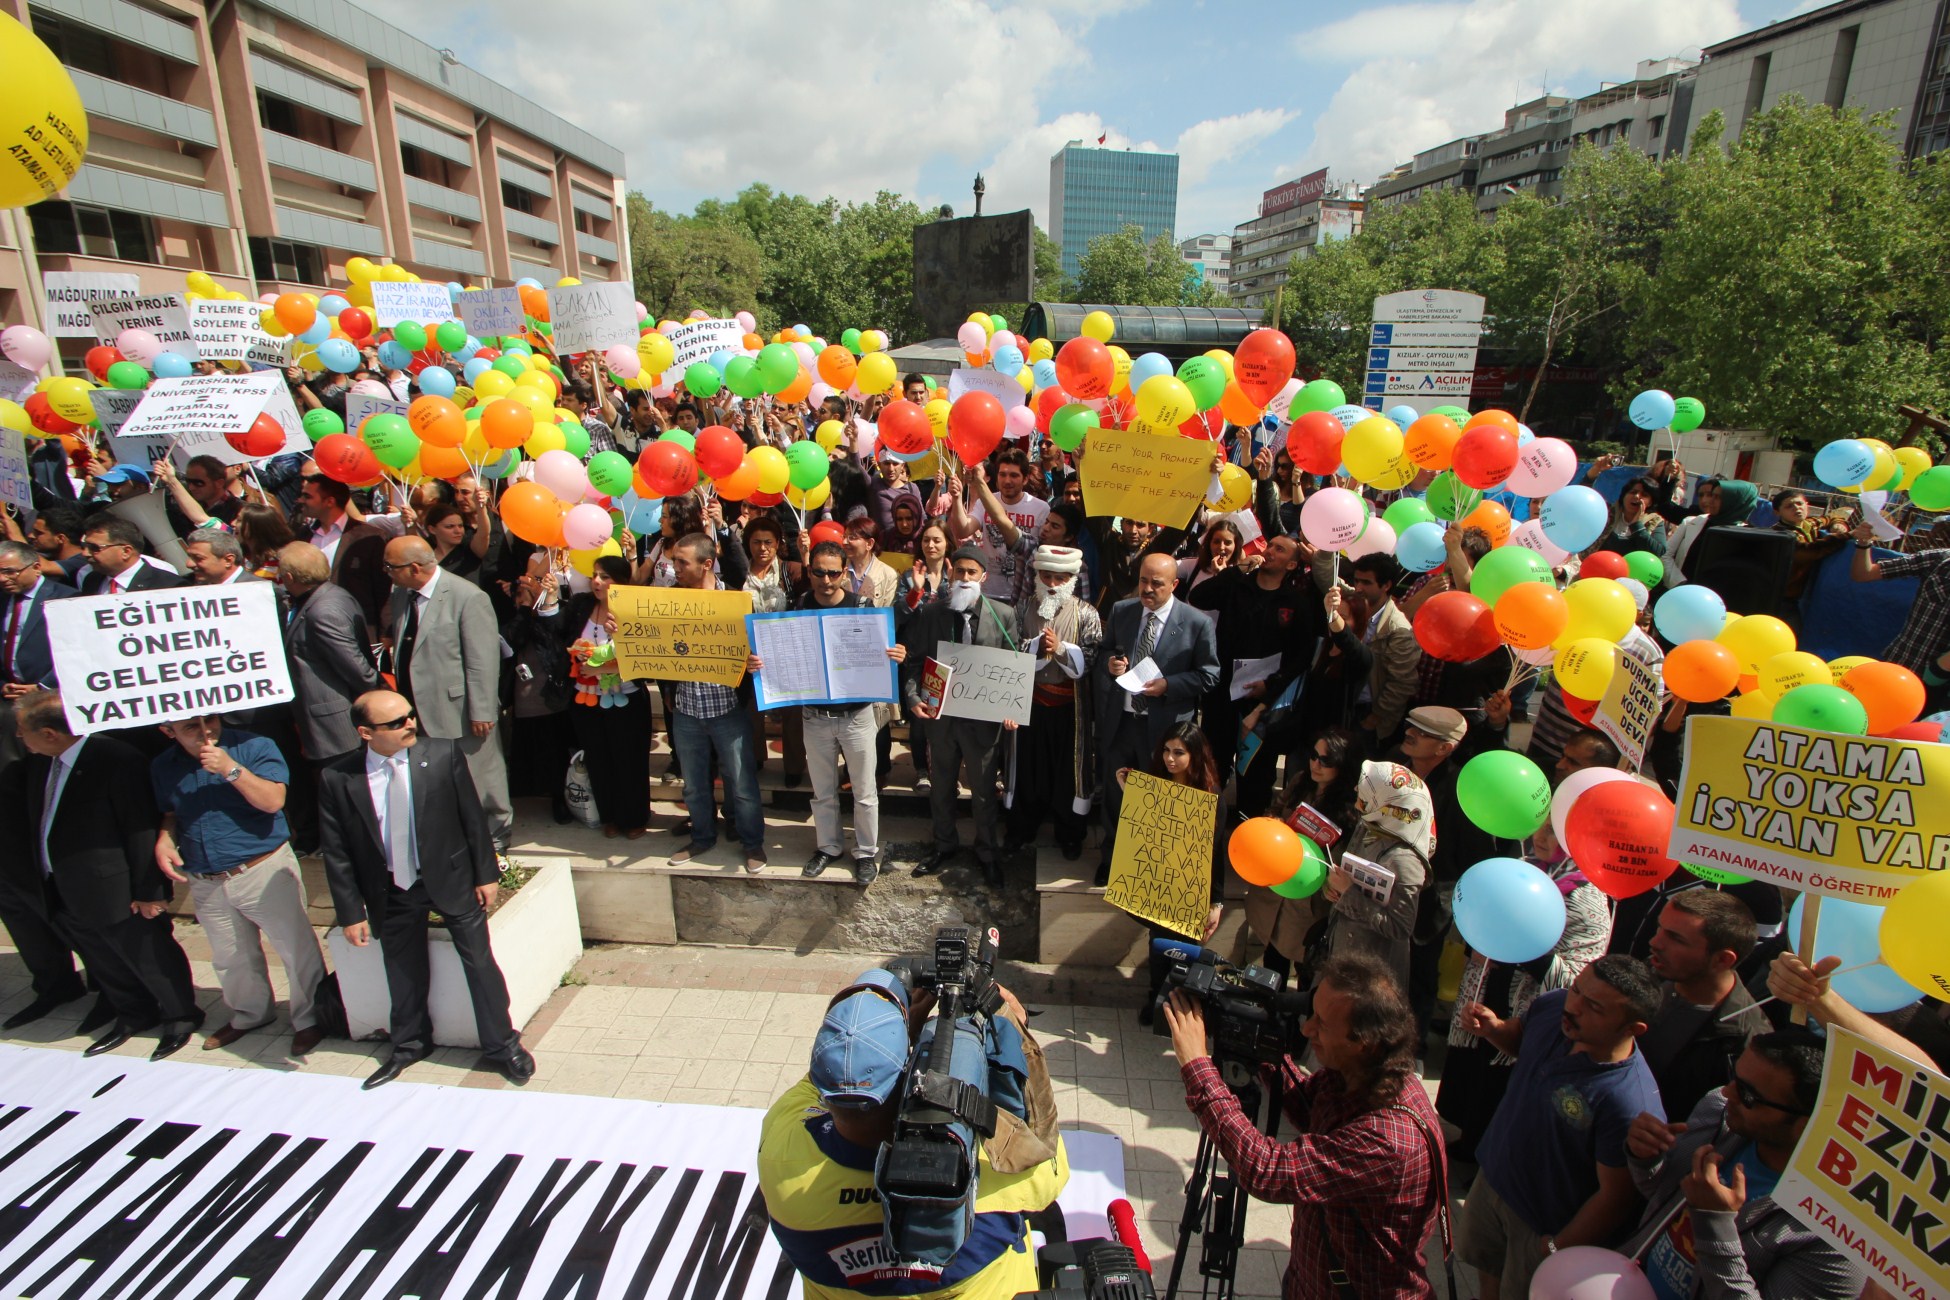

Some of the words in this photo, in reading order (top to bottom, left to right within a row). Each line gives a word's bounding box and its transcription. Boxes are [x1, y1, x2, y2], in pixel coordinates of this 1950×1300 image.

[1263, 188, 1295, 210] TÜRKİYE
[1296, 177, 1326, 198] FİNANS
[48, 286, 116, 302] MAĞDURUM
[375, 283, 421, 292] DURMAK
[427, 284, 445, 296] YOK
[92, 301, 134, 316] ÇILGIN
[138, 297, 178, 311] PROJE
[199, 305, 244, 314] EYLEME
[554, 288, 613, 317] BAKAN
[58, 311, 91, 327] MAĞD
[378, 308, 421, 319] ATAMAYA
[422, 308, 454, 319] DEVAM
[474, 306, 512, 318] OKULA
[117, 315, 164, 329] YERİNE
[194, 320, 247, 329] SÖYLEME
[697, 322, 736, 332] PROJE
[195, 334, 237, 342] ADALET
[242, 335, 285, 350] YERİNİ
[677, 334, 718, 350] YERİNE
[248, 350, 284, 364] ÖMER
[1426, 352, 1454, 360] ÇAYYOLU
[181, 378, 250, 387] DERSHANE
[1435, 376, 1471, 386] AÇILIM
[151, 388, 228, 398] ÜNİVERSİTE,
[232, 388, 268, 396] KPSS
[147, 412, 239, 421] YAPILMAYAN
[129, 421, 243, 432] ÖĞRETMENLER
[1092, 441, 1122, 453] KEEP
[1132, 447, 1153, 460] YOUR
[1160, 452, 1202, 465] PROMISE
[1111, 462, 1153, 476] ASSIGN
[1090, 480, 1133, 492] BEFORE
[1140, 486, 1164, 496] THE
[94, 597, 241, 630] EĞİTİME
[672, 624, 737, 637] ATAMA!!!
[118, 628, 232, 657] ÖNEM,
[618, 642, 672, 655] TEKNİK
[86, 649, 267, 693] GELECEĞE
[632, 660, 669, 672] ATMA
[671, 660, 726, 675] YABANA!!!
[950, 656, 973, 676] BU
[976, 664, 1027, 689] SEFER
[76, 678, 284, 724] YATIRIMDIR.
[1629, 680, 1656, 714] ÜCRE
[1600, 720, 1629, 753] ATANAMAYAN
[1744, 726, 1925, 786] ATAMA
[1162, 780, 1195, 806] SÖZÜ
[1196, 791, 1218, 812] VAR
[1744, 763, 1916, 827] YOKSA
[1143, 792, 1179, 818] OKUL
[1184, 804, 1211, 829] VAR
[1691, 782, 1839, 857] İSYAN
[1856, 826, 1950, 871] VAR
[1128, 822, 1181, 852] TABLET
[1183, 840, 1210, 863] VAR
[1195, 826, 1214, 847] VAR
[1177, 853, 1205, 878] VAR
[1688, 843, 1803, 884] ATANAMAYAN
[1134, 859, 1181, 885] TALEP
[1182, 872, 1209, 898] VAR
[1110, 874, 1174, 904] ATAMA
